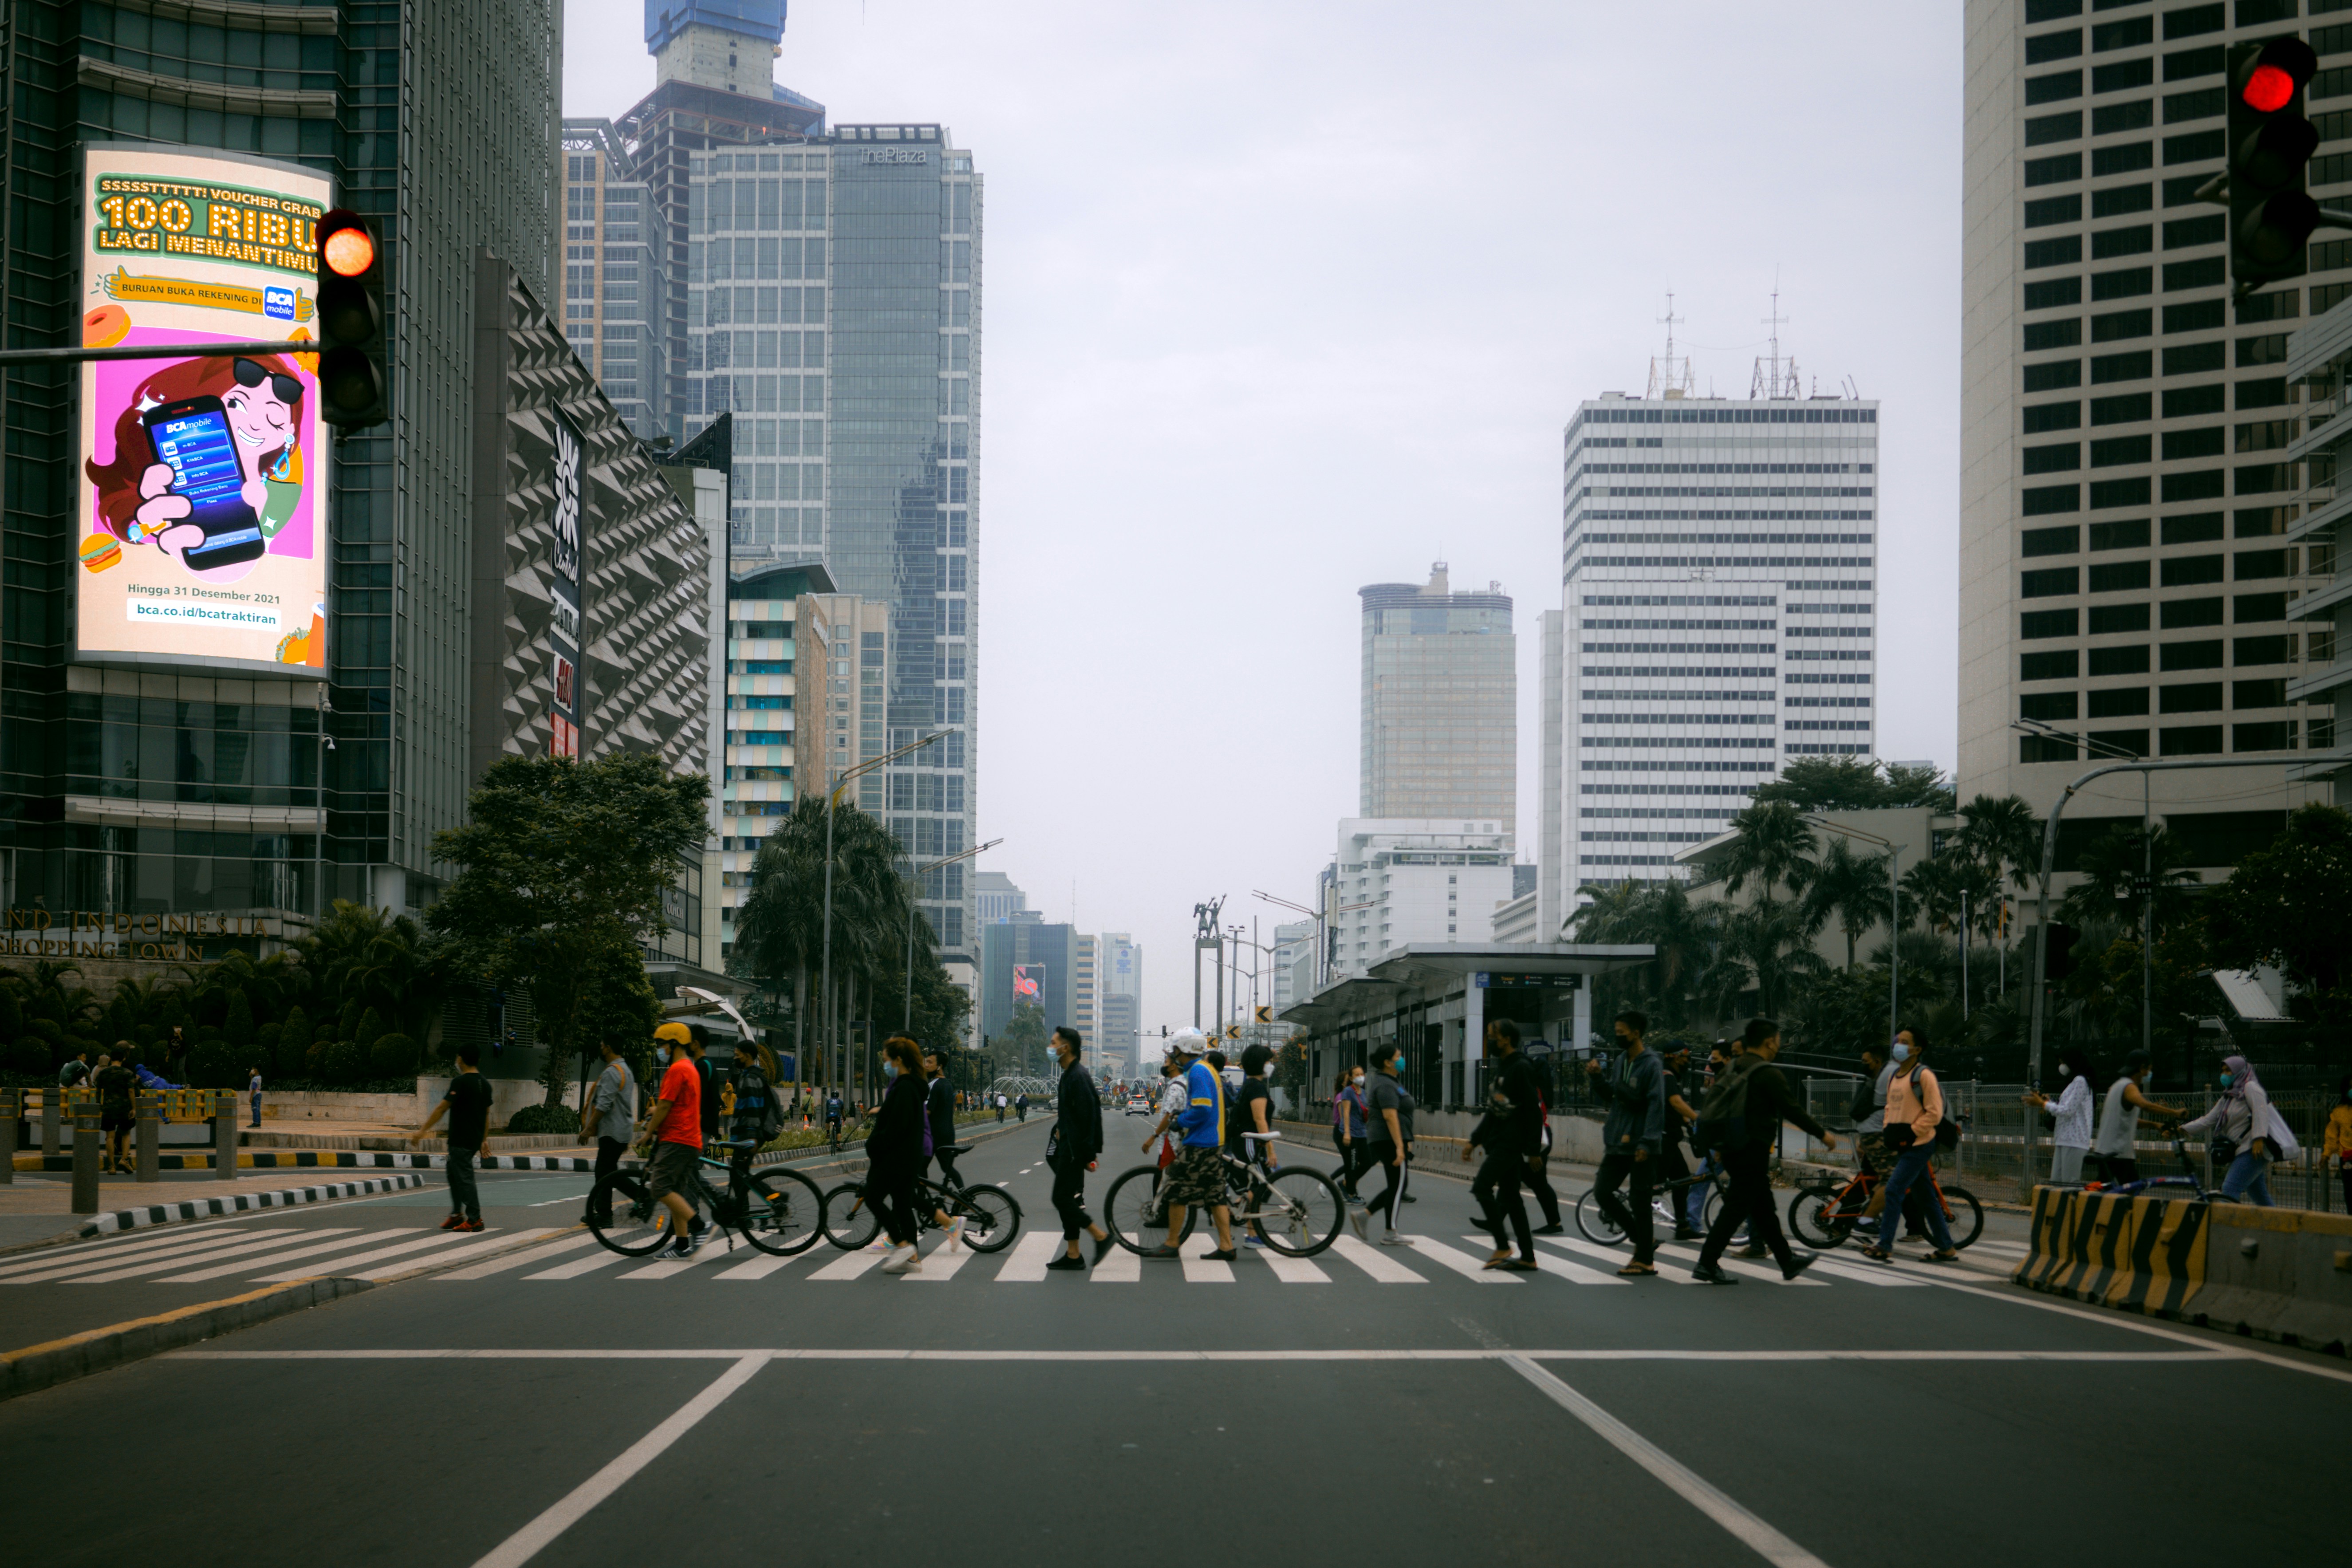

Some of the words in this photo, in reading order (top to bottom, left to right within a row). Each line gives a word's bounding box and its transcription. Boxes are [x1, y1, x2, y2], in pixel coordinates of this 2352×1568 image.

[102, 180, 207, 198] SSSSSTTTTT!
[210, 188, 278, 209] VOUCHER
[281, 201, 321, 219] GRAB
[101, 196, 191, 232] 100
[209, 204, 317, 252] RIBU
[100, 230, 158, 250] LAGI
[167, 234, 318, 273] MENANTIMU
[122, 284, 164, 293] BURUAN
[167, 287, 195, 296] BUKA
[198, 290, 248, 303] REKENING
[267, 292, 293, 306] BCA
[266, 306, 292, 315] mobile
[555, 537, 579, 587] Central
[128, 584, 169, 596] Hingga
[174, 587, 186, 595] 31
[192, 588, 251, 601] Desember
[254, 594, 280, 604] 2021
[138, 604, 276, 624] bca.co.id/bcatraktiran
[667, 904, 683, 919] COACH
[0, 909, 52, 931] ND
[70, 910, 268, 938] INDONESIA
[123, 940, 203, 962] TOWN
